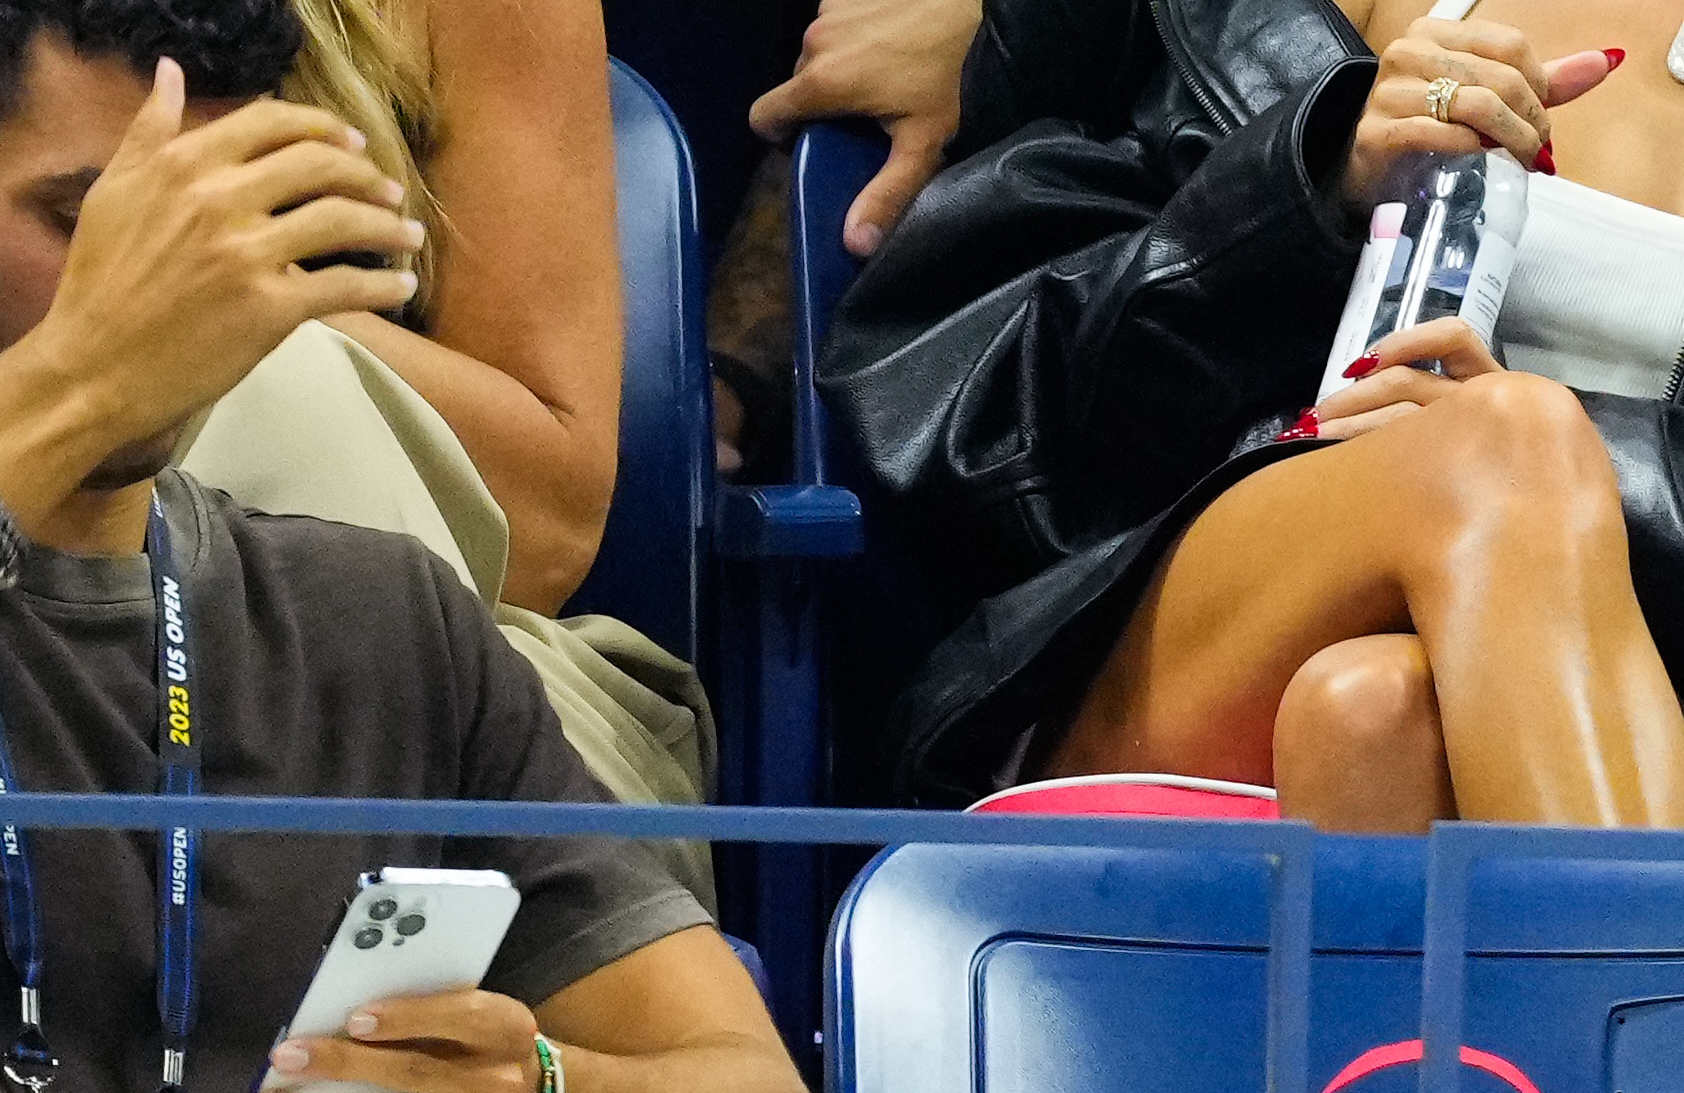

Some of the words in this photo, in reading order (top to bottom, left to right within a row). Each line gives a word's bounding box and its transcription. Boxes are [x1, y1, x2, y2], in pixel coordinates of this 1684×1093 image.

[162, 576, 184, 644] OPEN
[167, 646, 187, 682] US
[168, 685, 190, 747] 2023
[172, 826, 188, 905] #USOPEN
